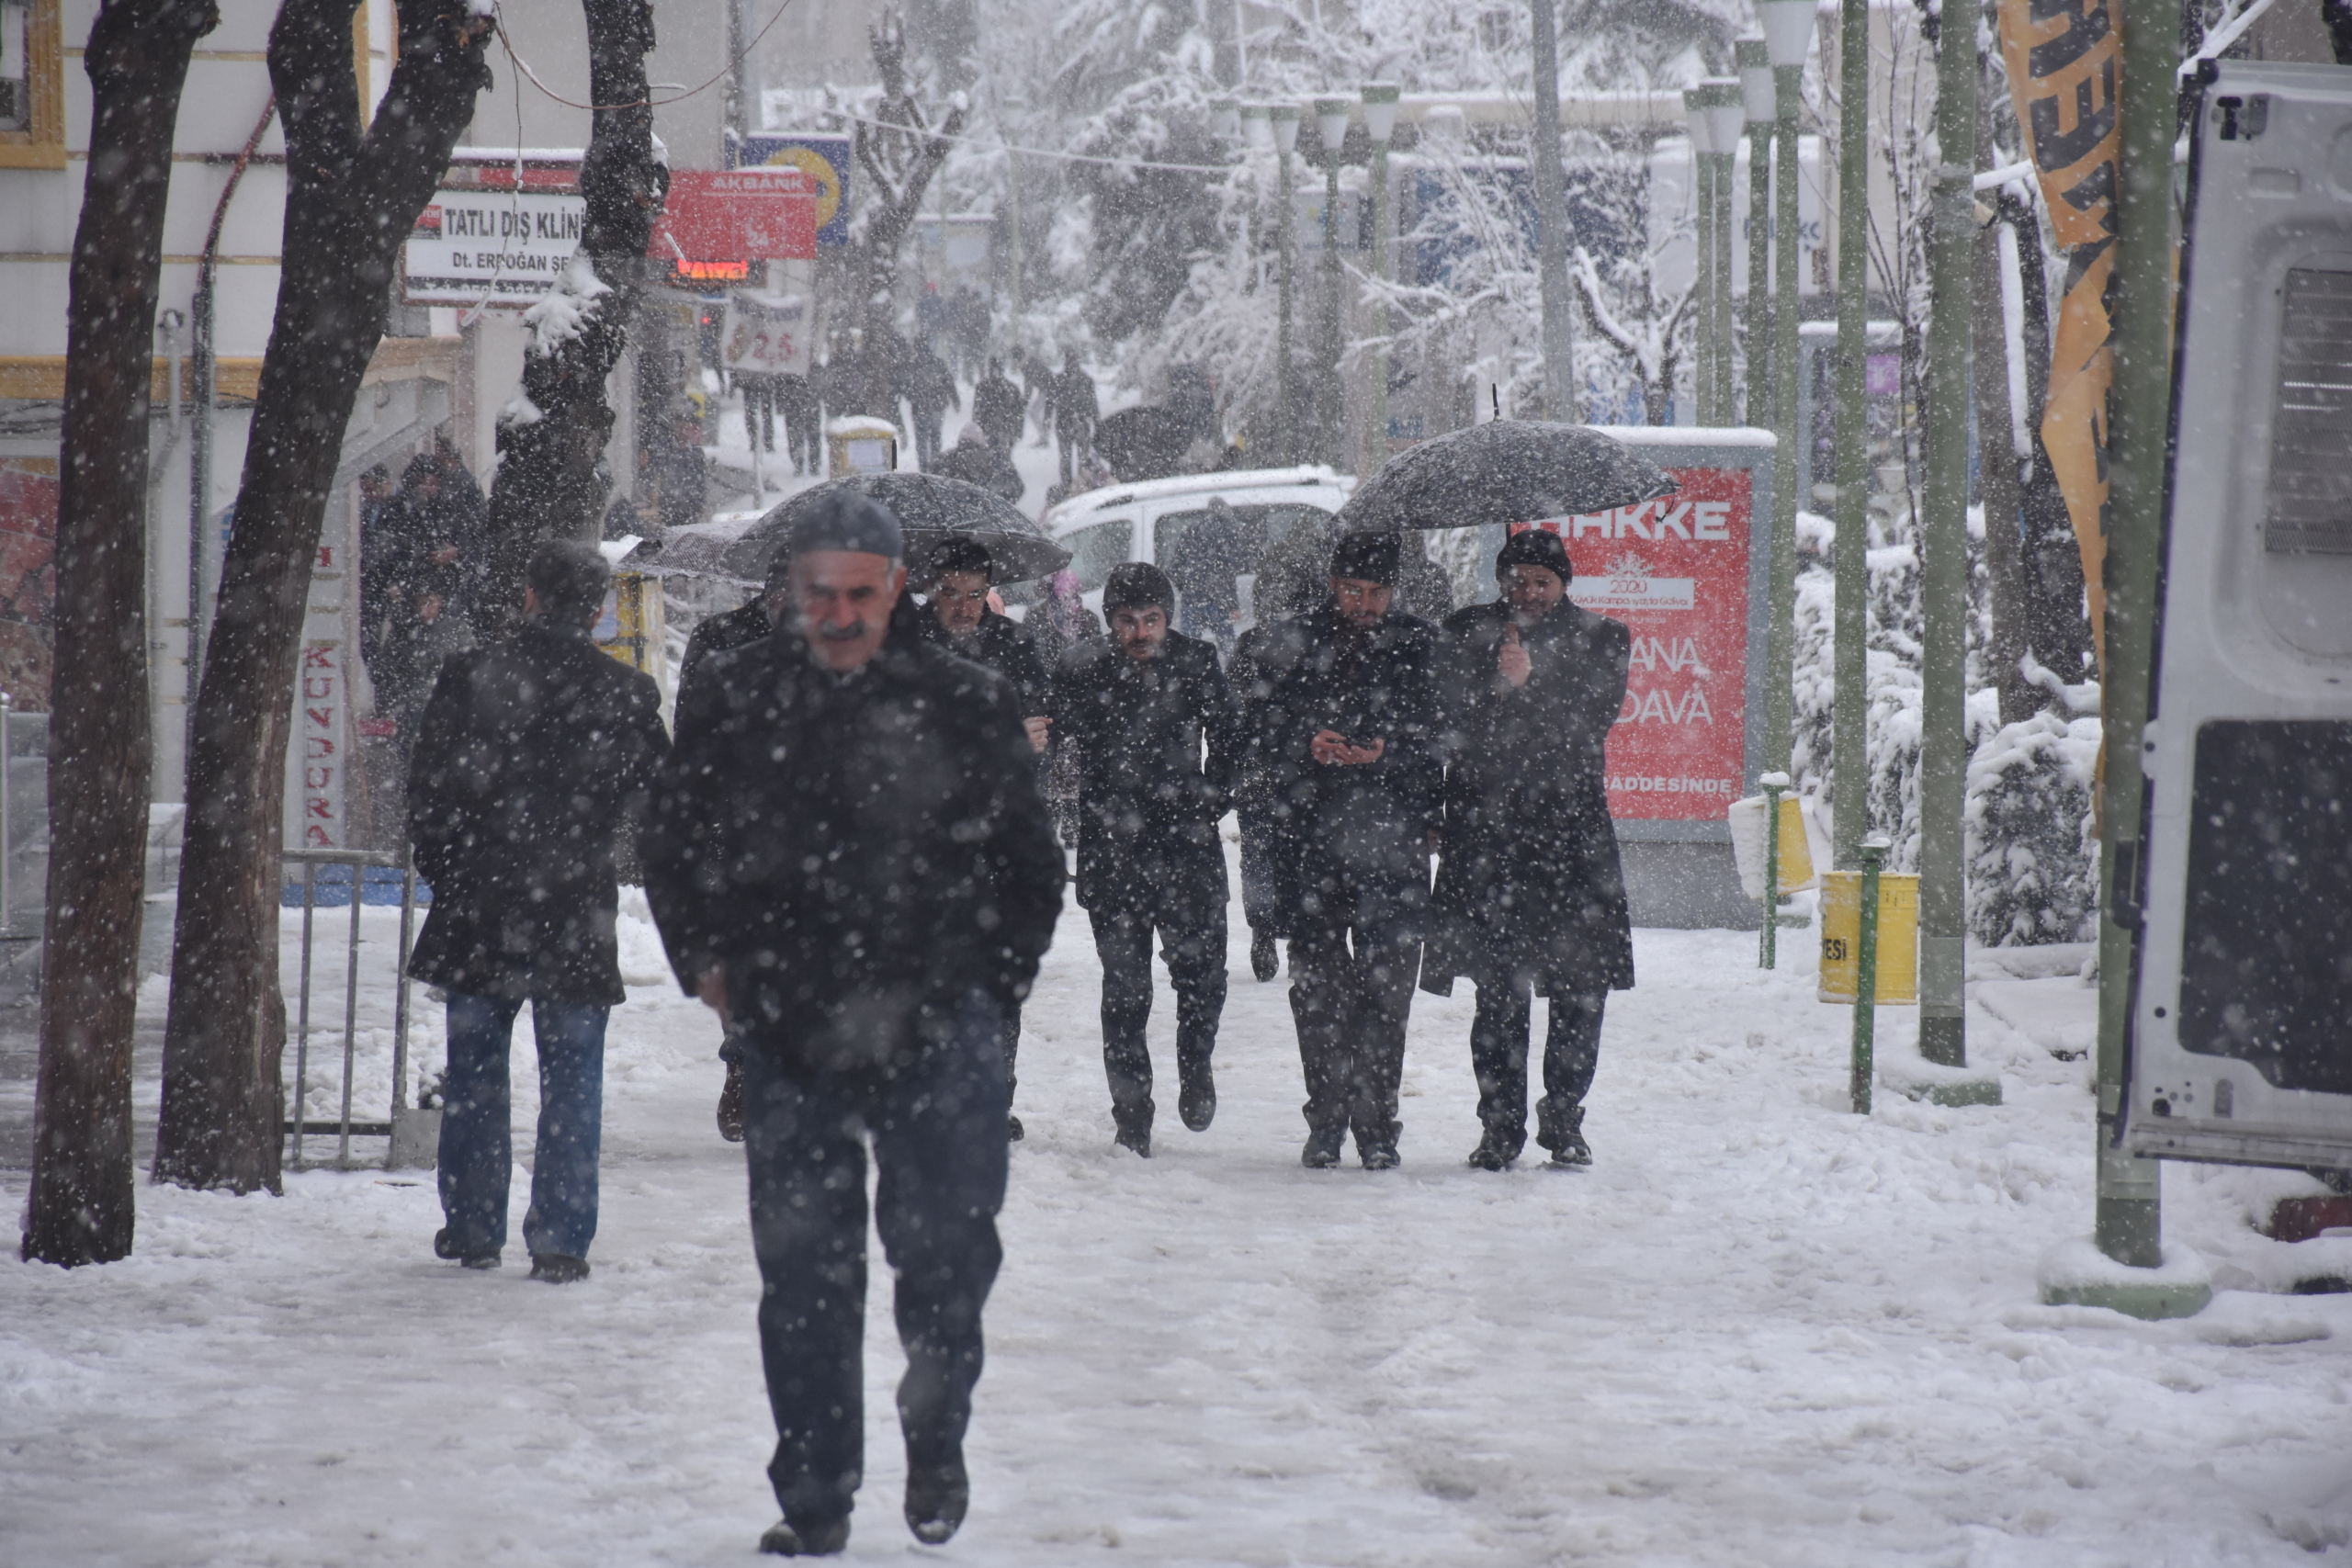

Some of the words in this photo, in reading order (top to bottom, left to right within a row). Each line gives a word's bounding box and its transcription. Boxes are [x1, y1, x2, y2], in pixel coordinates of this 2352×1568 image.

[712, 177, 806, 192] AKBANK
[445, 209, 494, 237] TATLI
[453, 252, 472, 268] Dt.
[477, 251, 547, 271] ERDOĞAN
[1610, 579, 1647, 593] 2020
[1628, 636, 1702, 671] ANA
[1615, 687, 1713, 725] DAVA
